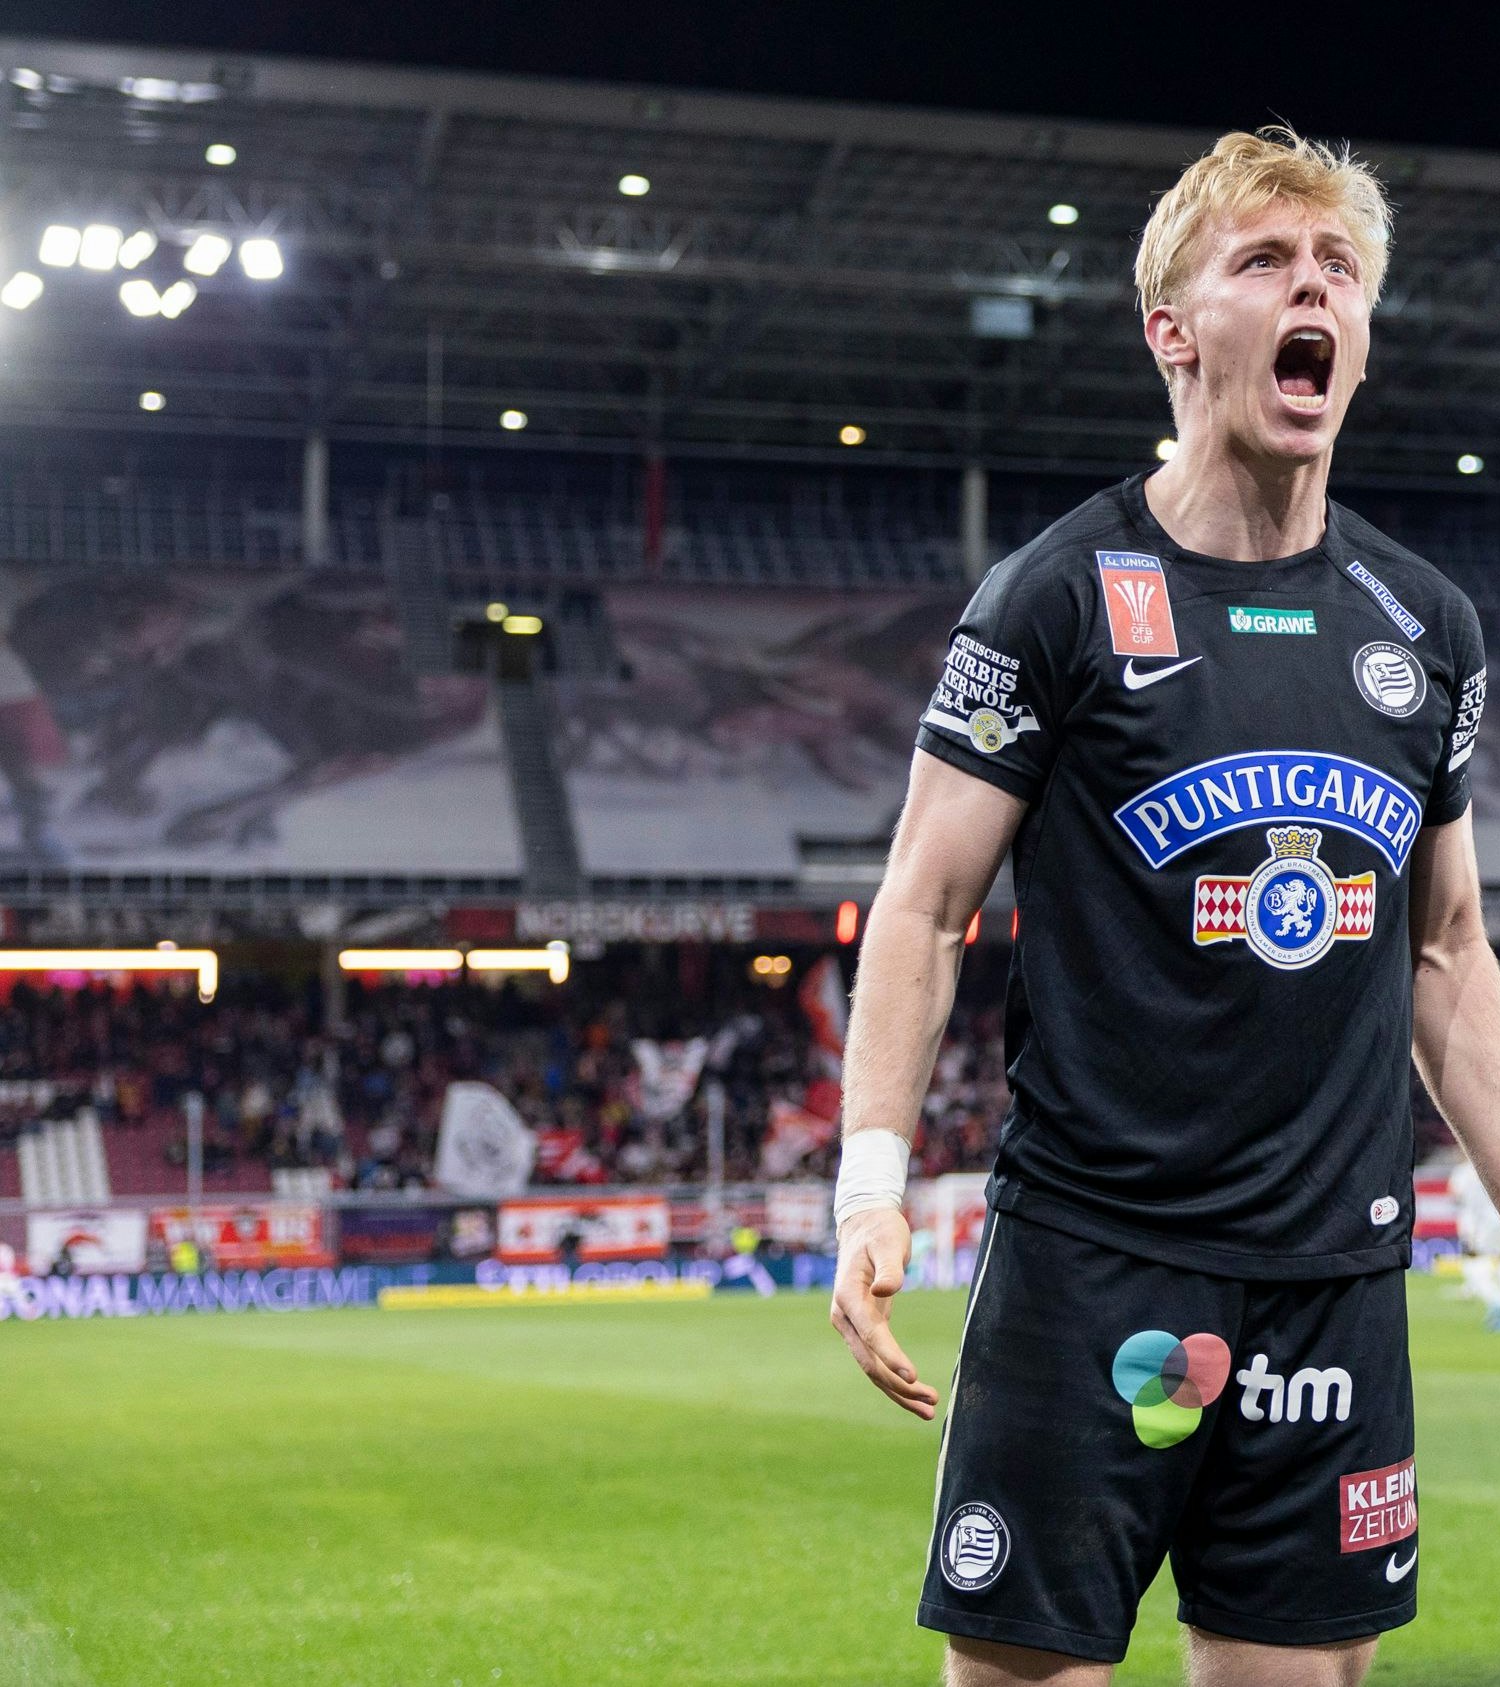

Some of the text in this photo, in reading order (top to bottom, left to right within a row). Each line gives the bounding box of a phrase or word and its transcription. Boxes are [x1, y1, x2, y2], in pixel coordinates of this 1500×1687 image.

[1121, 558, 1157, 569] UNIQA
[1354, 564, 1419, 636] PUNTIGAMER
[1132, 635, 1154, 644] CUP
[1253, 615, 1317, 633] GRAWE
[1362, 645, 1411, 660] SK STURM GRAZ
[1133, 763, 1418, 858] PUNTIGAMER
[1287, 861, 1334, 902] BRAUTRADITION
[1249, 910, 1276, 955] PUNTIGAMER
[1277, 952, 1293, 960] DAS
[1322, 910, 1334, 932] BIER
[1236, 1354, 1353, 1423] tim
[1348, 1463, 1416, 1511] KLEIN
[959, 1506, 1002, 1531] SK STURM GRAZ
[1348, 1501, 1417, 1543] ZEITUN
[948, 1571, 961, 1583] SEIT
